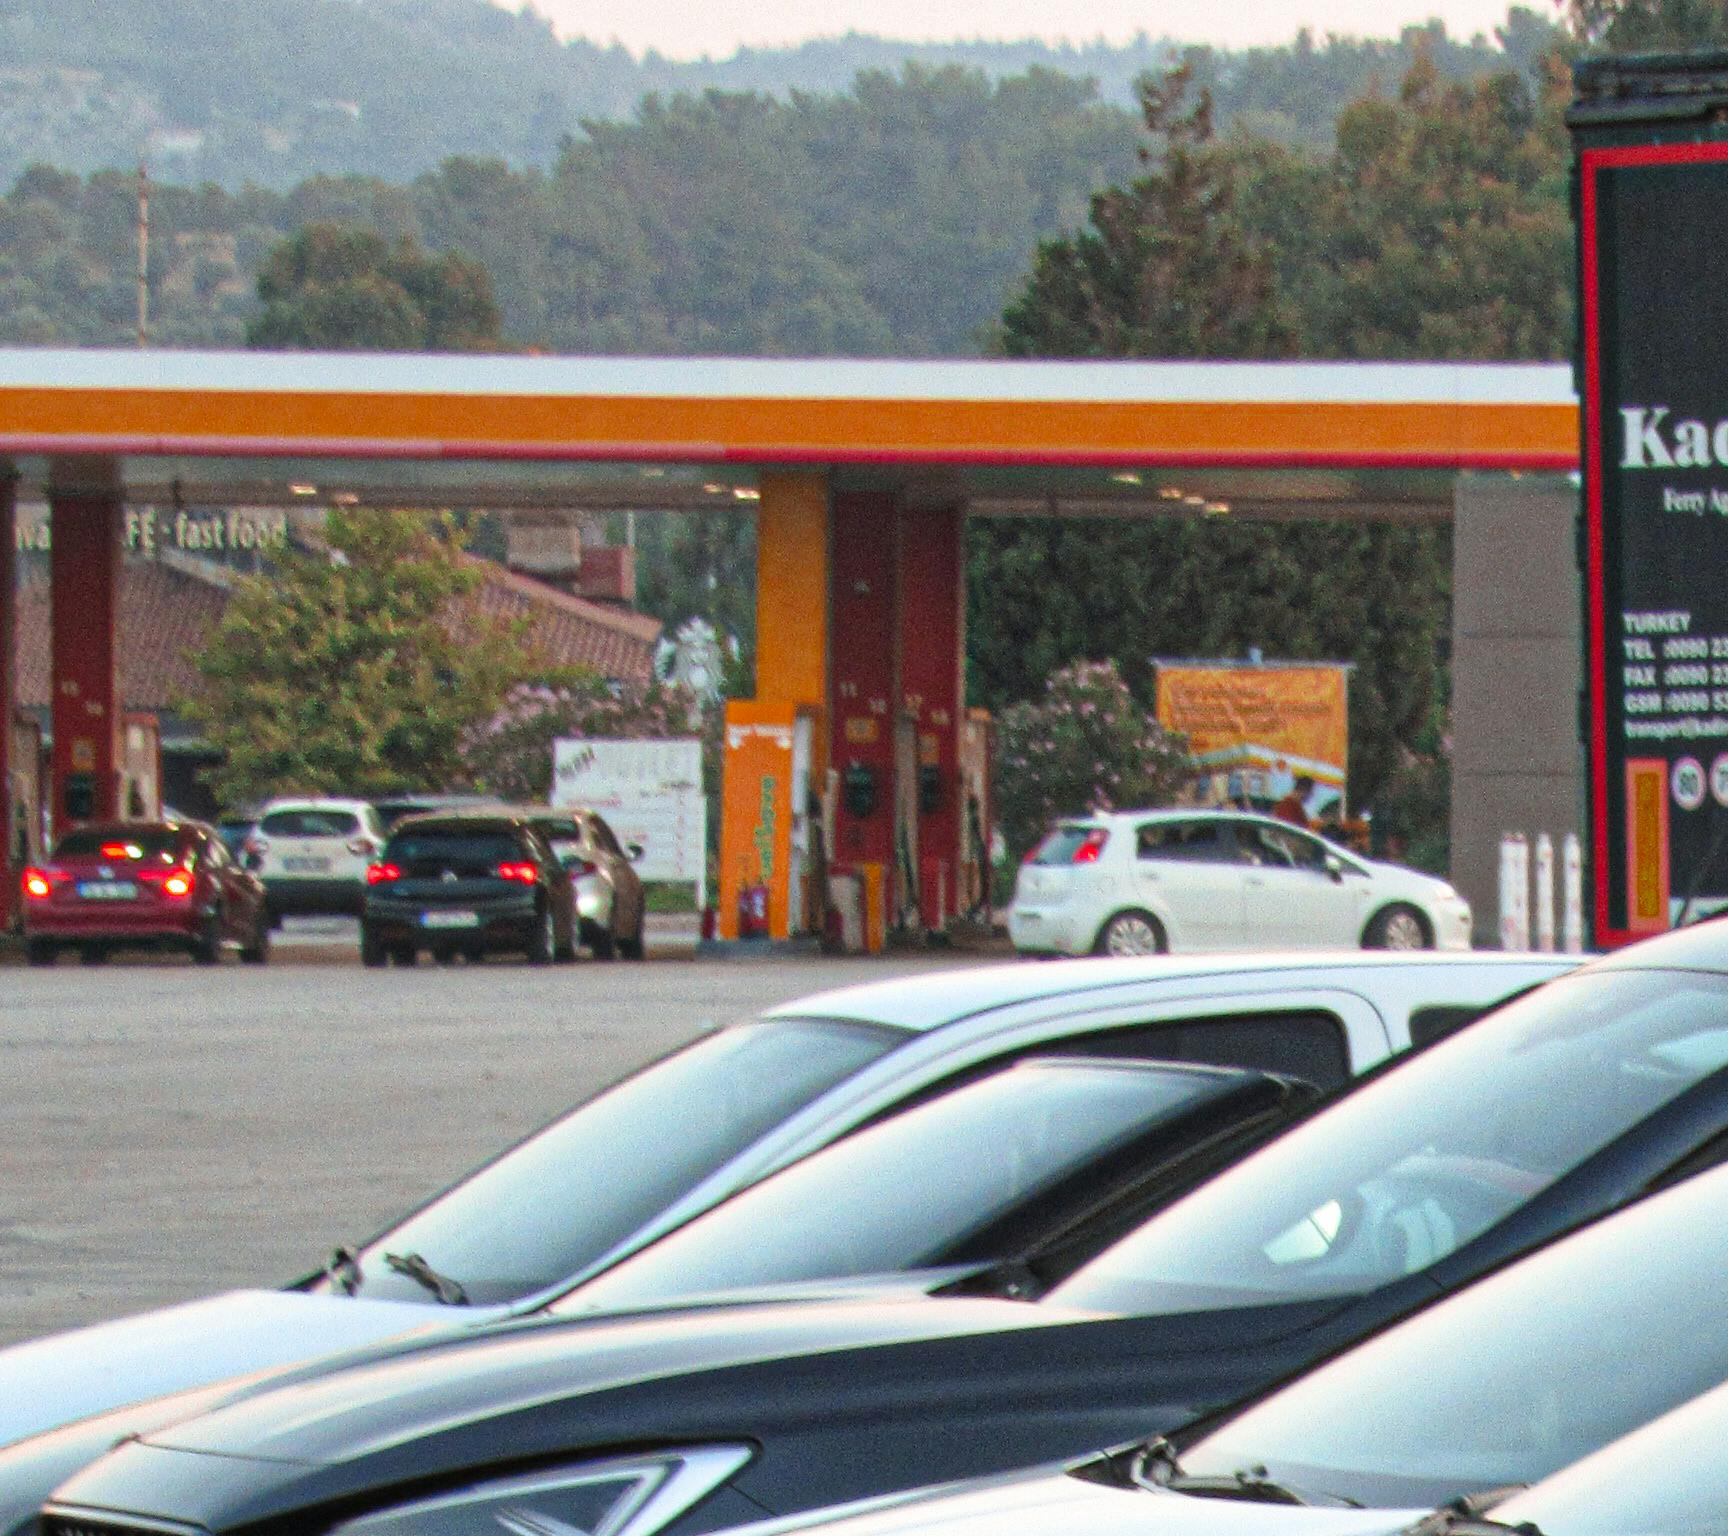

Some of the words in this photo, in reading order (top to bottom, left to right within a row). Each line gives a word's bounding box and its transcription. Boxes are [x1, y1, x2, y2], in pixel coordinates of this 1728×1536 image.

[1664, 486, 1702, 515] Ferry
[175, 510, 225, 550] fast
[228, 509, 289, 551] food
[1622, 609, 1692, 634] TURKEY
[1622, 636, 1657, 660] TEL
[1622, 663, 1657, 688] FAX
[1622, 689, 1662, 714] GSM
